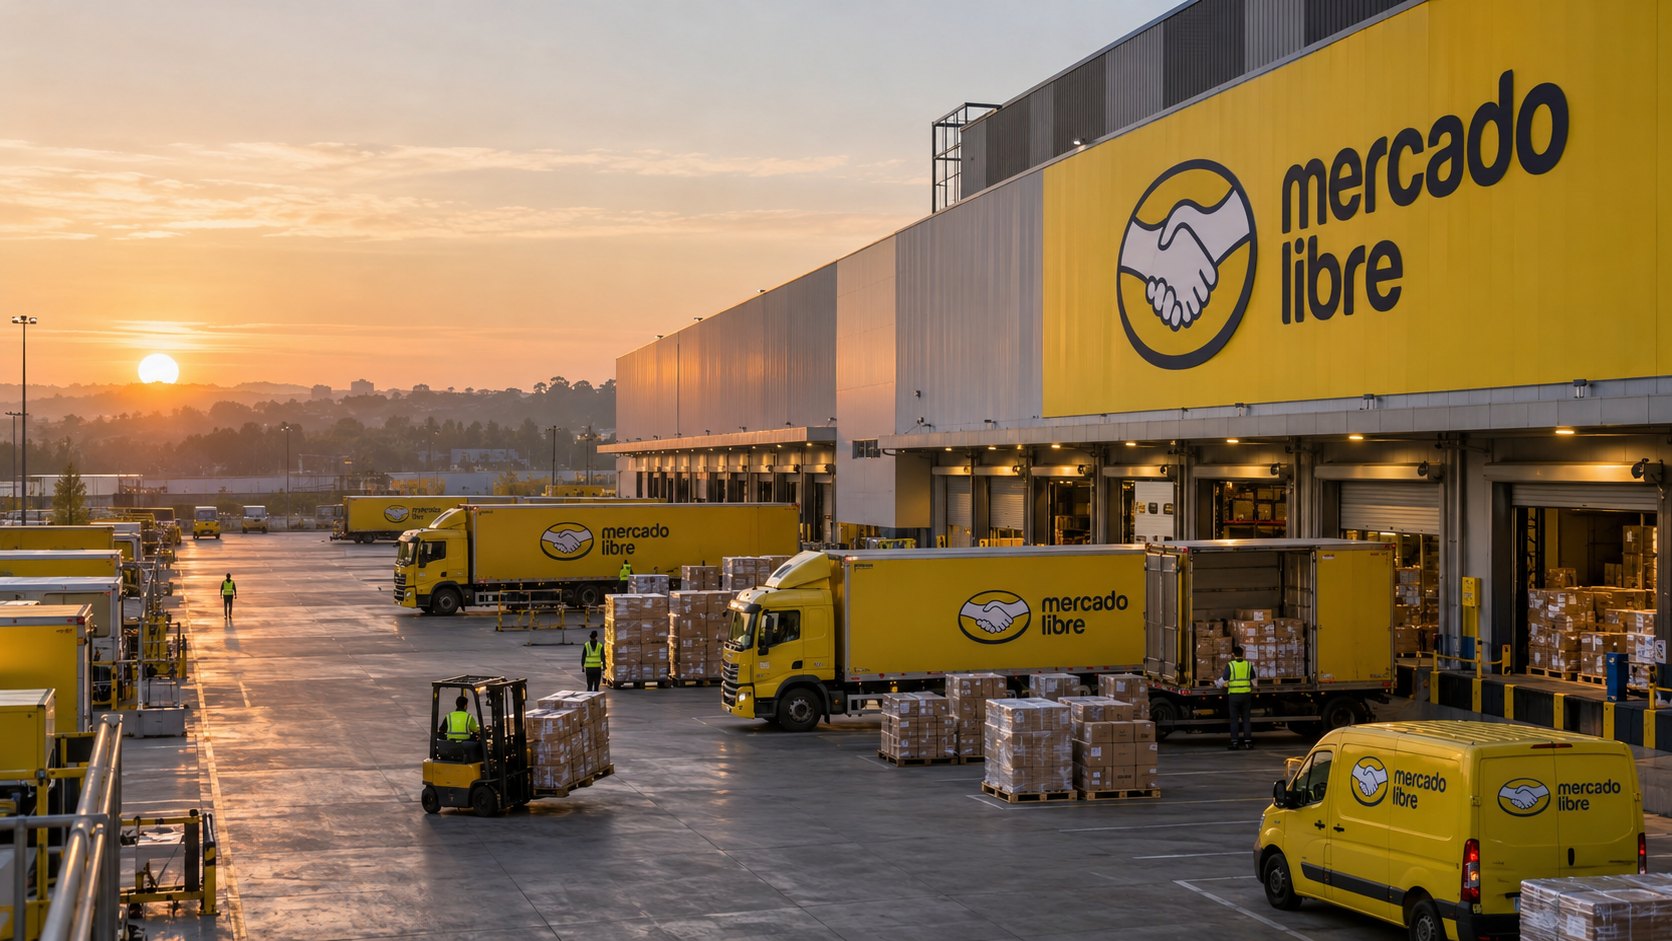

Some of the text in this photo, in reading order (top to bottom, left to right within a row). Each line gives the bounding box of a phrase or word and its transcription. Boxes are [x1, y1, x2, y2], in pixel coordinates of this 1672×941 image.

[1282, 69, 1571, 235] mercado
[1282, 235, 1404, 325] libre
[602, 523, 670, 540] mercado
[602, 540, 636, 556] libre
[1042, 590, 1129, 612] mercado
[1042, 614, 1086, 636] libre
[1393, 769, 1447, 793] mercado
[1558, 778, 1622, 795] mercado
[1393, 786, 1418, 810] libre
[1558, 796, 1590, 811] libre
